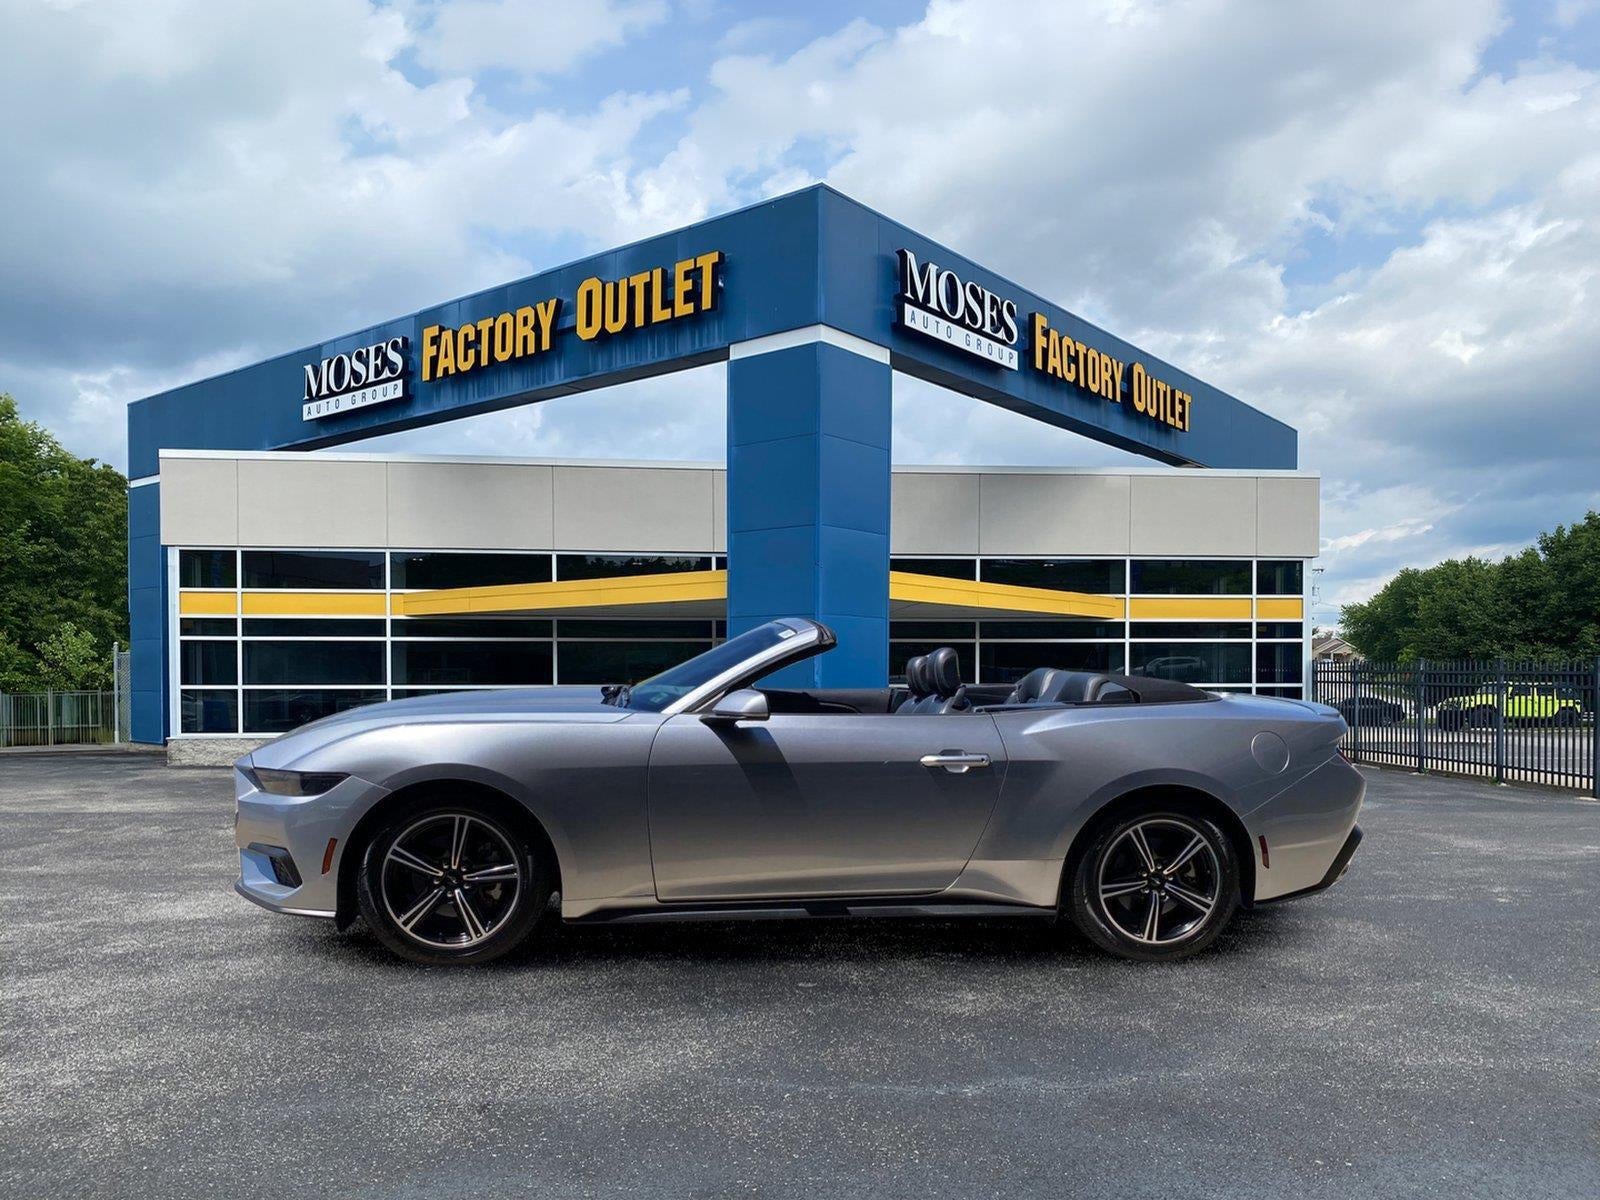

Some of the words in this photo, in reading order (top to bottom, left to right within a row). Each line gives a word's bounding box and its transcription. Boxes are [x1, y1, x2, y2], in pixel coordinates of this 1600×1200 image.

[422, 299, 558, 381] FACTORY
[576, 251, 719, 341] OUTLET
[904, 249, 1018, 344] MOSES
[303, 337, 403, 400] MOSES
[910, 309, 953, 340] AUTO
[965, 334, 1015, 364] GROUP
[1034, 312, 1124, 403] FACTORY
[1131, 362, 1192, 432] OUTLET
[307, 400, 341, 416] AUTO
[351, 383, 400, 405] GROUP
